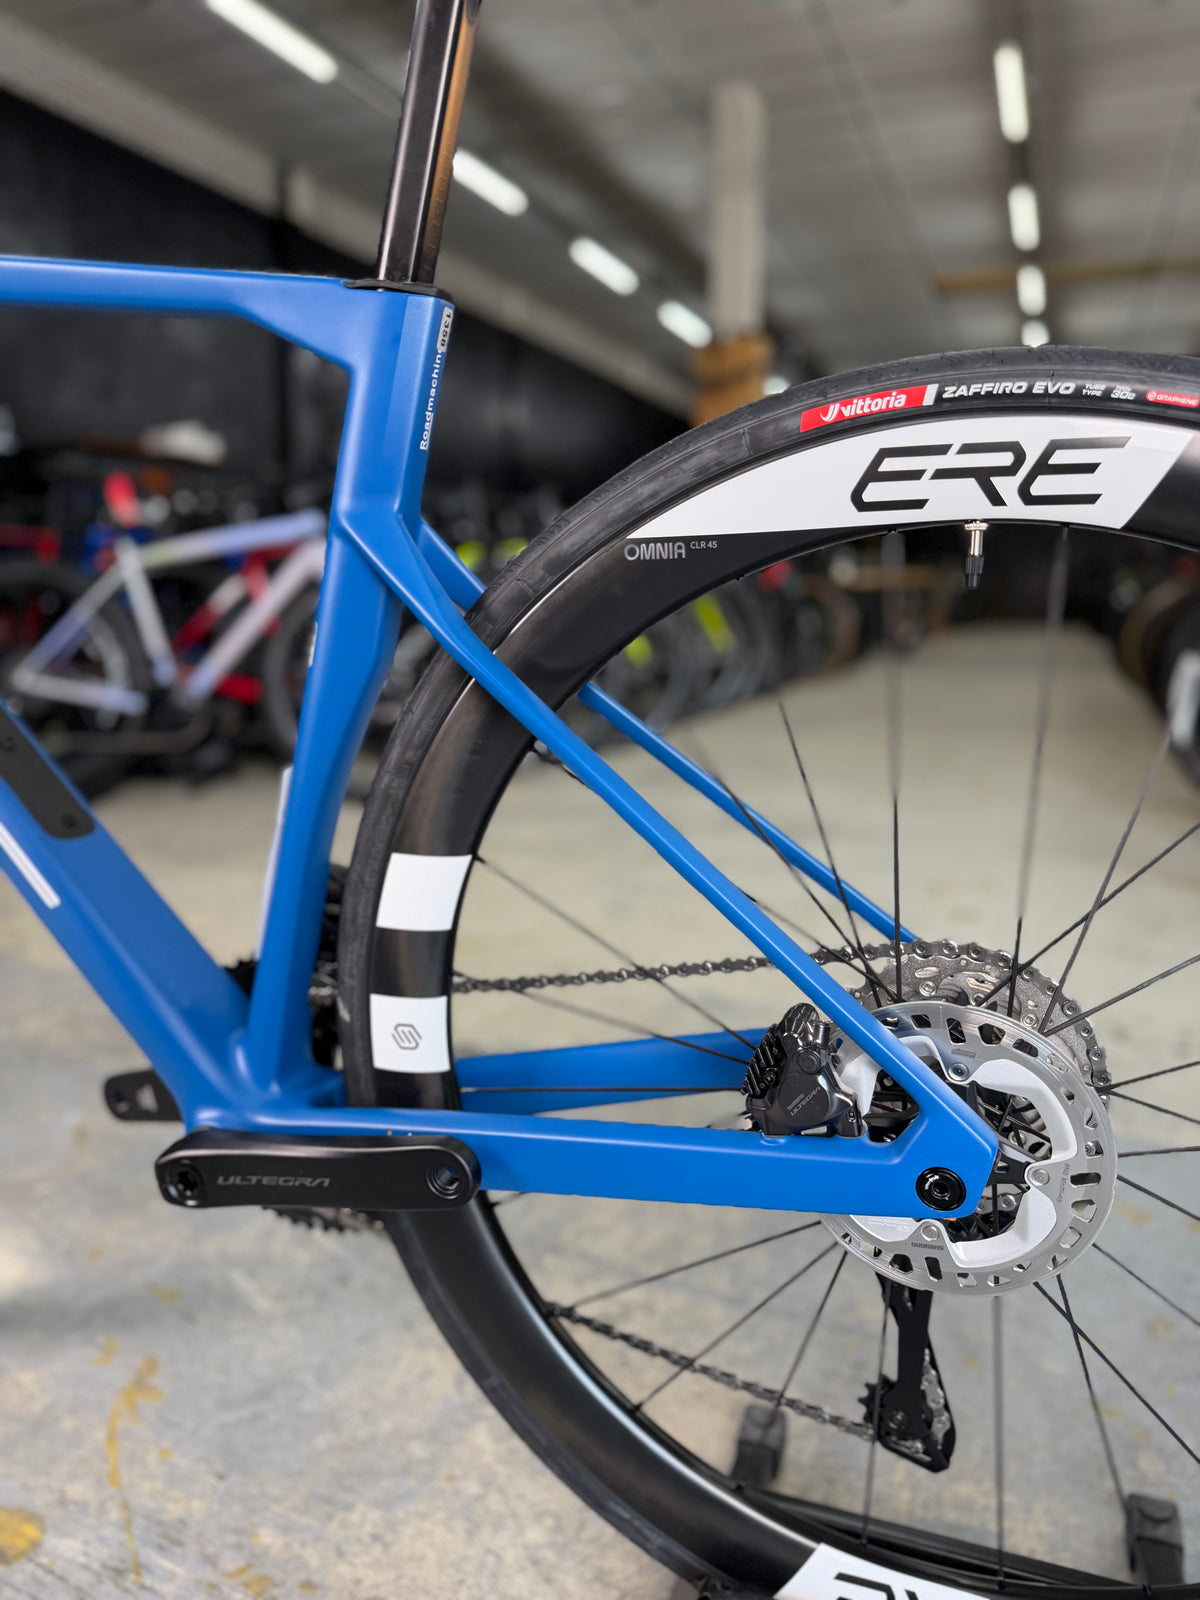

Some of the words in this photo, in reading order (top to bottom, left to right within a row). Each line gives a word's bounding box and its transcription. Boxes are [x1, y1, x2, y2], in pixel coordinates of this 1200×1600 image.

[942, 381, 1029, 399] ZAFFIRO
[1032, 381, 1077, 395] EVO
[1082, 389, 1102, 397] TYPE
[419, 349, 443, 451] Roadmachin
[840, 391, 907, 417] vittoria
[1156, 394, 1198, 406] GRAPHENE
[850, 436, 1132, 512] ERE
[624, 542, 686, 560] OMNIA
[690, 541, 706, 549] CLR
[707, 541, 718, 549] 45
[217, 1175, 331, 1188] ULTEGRA
